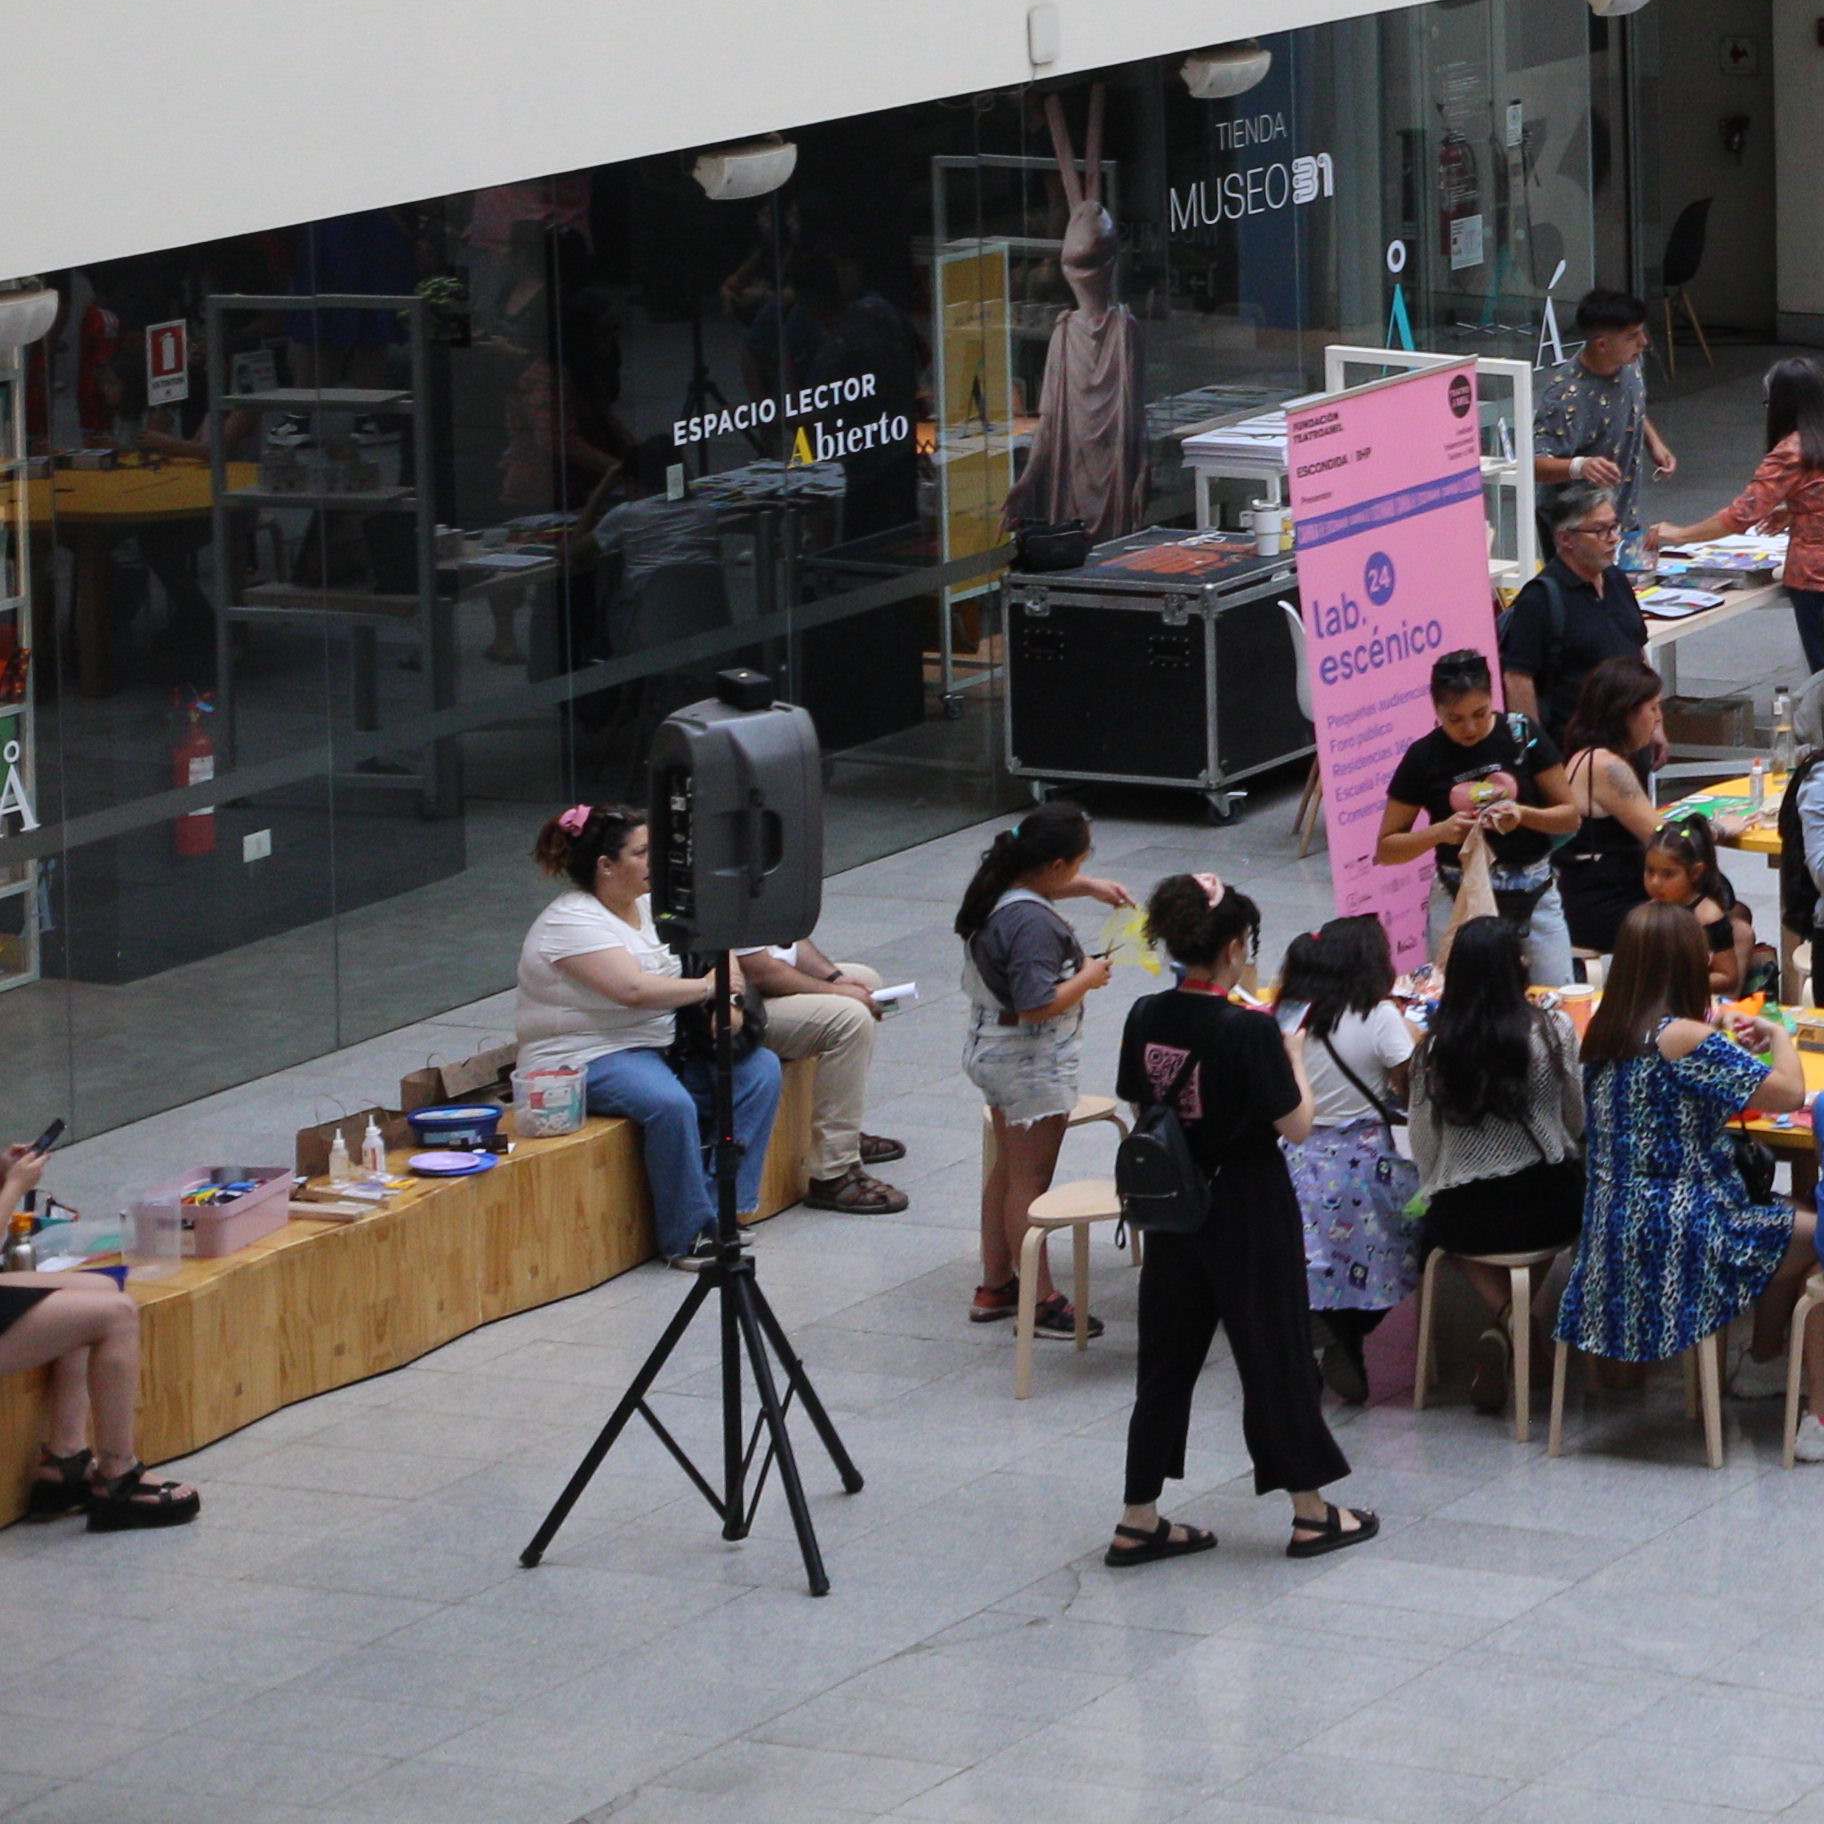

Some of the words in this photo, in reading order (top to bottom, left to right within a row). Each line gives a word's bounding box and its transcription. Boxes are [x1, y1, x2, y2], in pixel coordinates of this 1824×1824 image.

[1215, 111, 1287, 151] TIENDA
[1169, 163, 1289, 233] MUSEO
[673, 398, 776, 447] ESPACIO
[785, 373, 876, 418] LECTOR
[786, 411, 909, 469] Abierto
[1297, 455, 1348, 478] ESCONDIDA
[1368, 565, 1391, 593] 24
[1313, 592, 1366, 639] lab.
[1319, 620, 1442, 685] escénico
